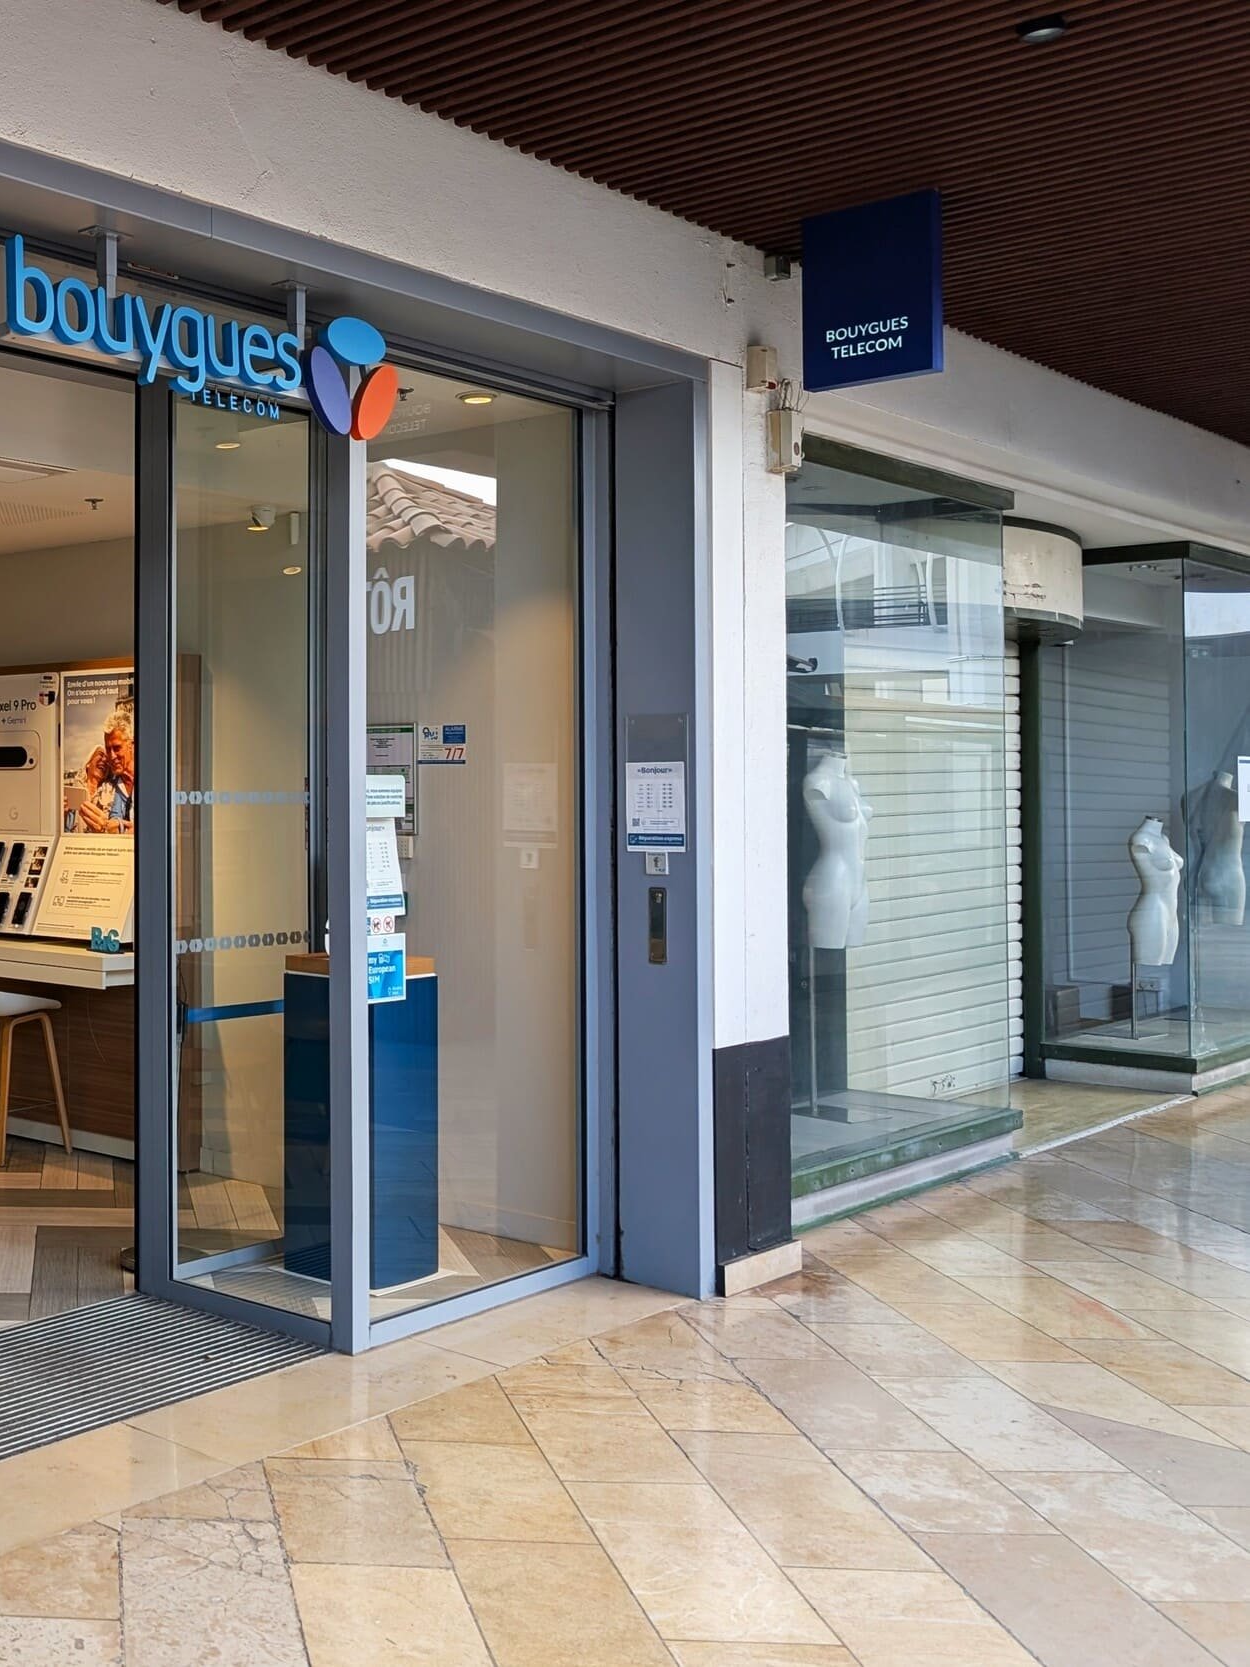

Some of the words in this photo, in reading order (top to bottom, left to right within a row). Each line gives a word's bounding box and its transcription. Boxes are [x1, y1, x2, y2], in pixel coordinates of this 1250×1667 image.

[5, 233, 302, 394] bouygues
[826, 316, 909, 343] BOUYGUES
[831, 335, 903, 360] TELECOM
[13, 700, 20, 711] 9
[21, 699, 37, 711] Pro
[444, 747, 464, 761] 7/7
